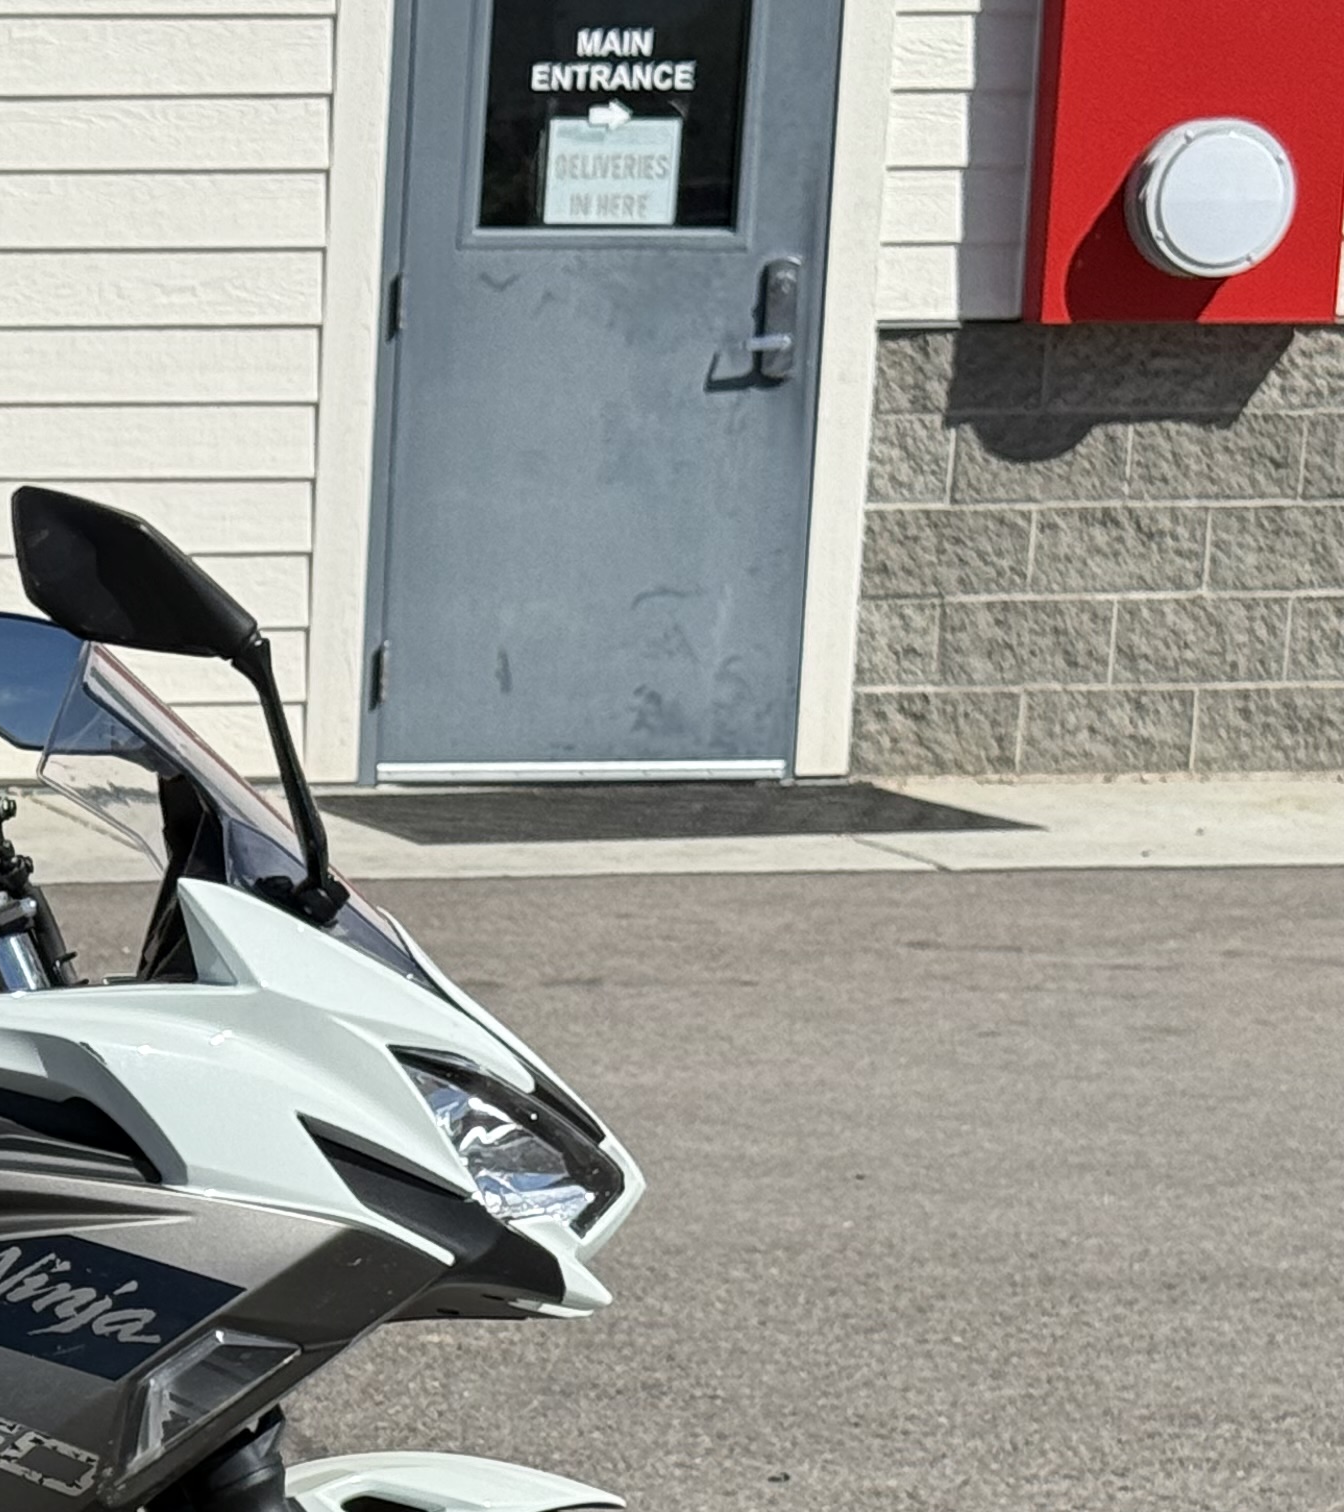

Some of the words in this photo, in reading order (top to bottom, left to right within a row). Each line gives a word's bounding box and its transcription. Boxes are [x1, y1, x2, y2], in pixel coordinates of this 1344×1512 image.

[576, 28, 654, 57] MAIN
[531, 61, 696, 92] ENTRANCE
[555, 153, 670, 180] DELIVERIES
[569, 193, 590, 217] IN
[596, 193, 649, 219] HERE
